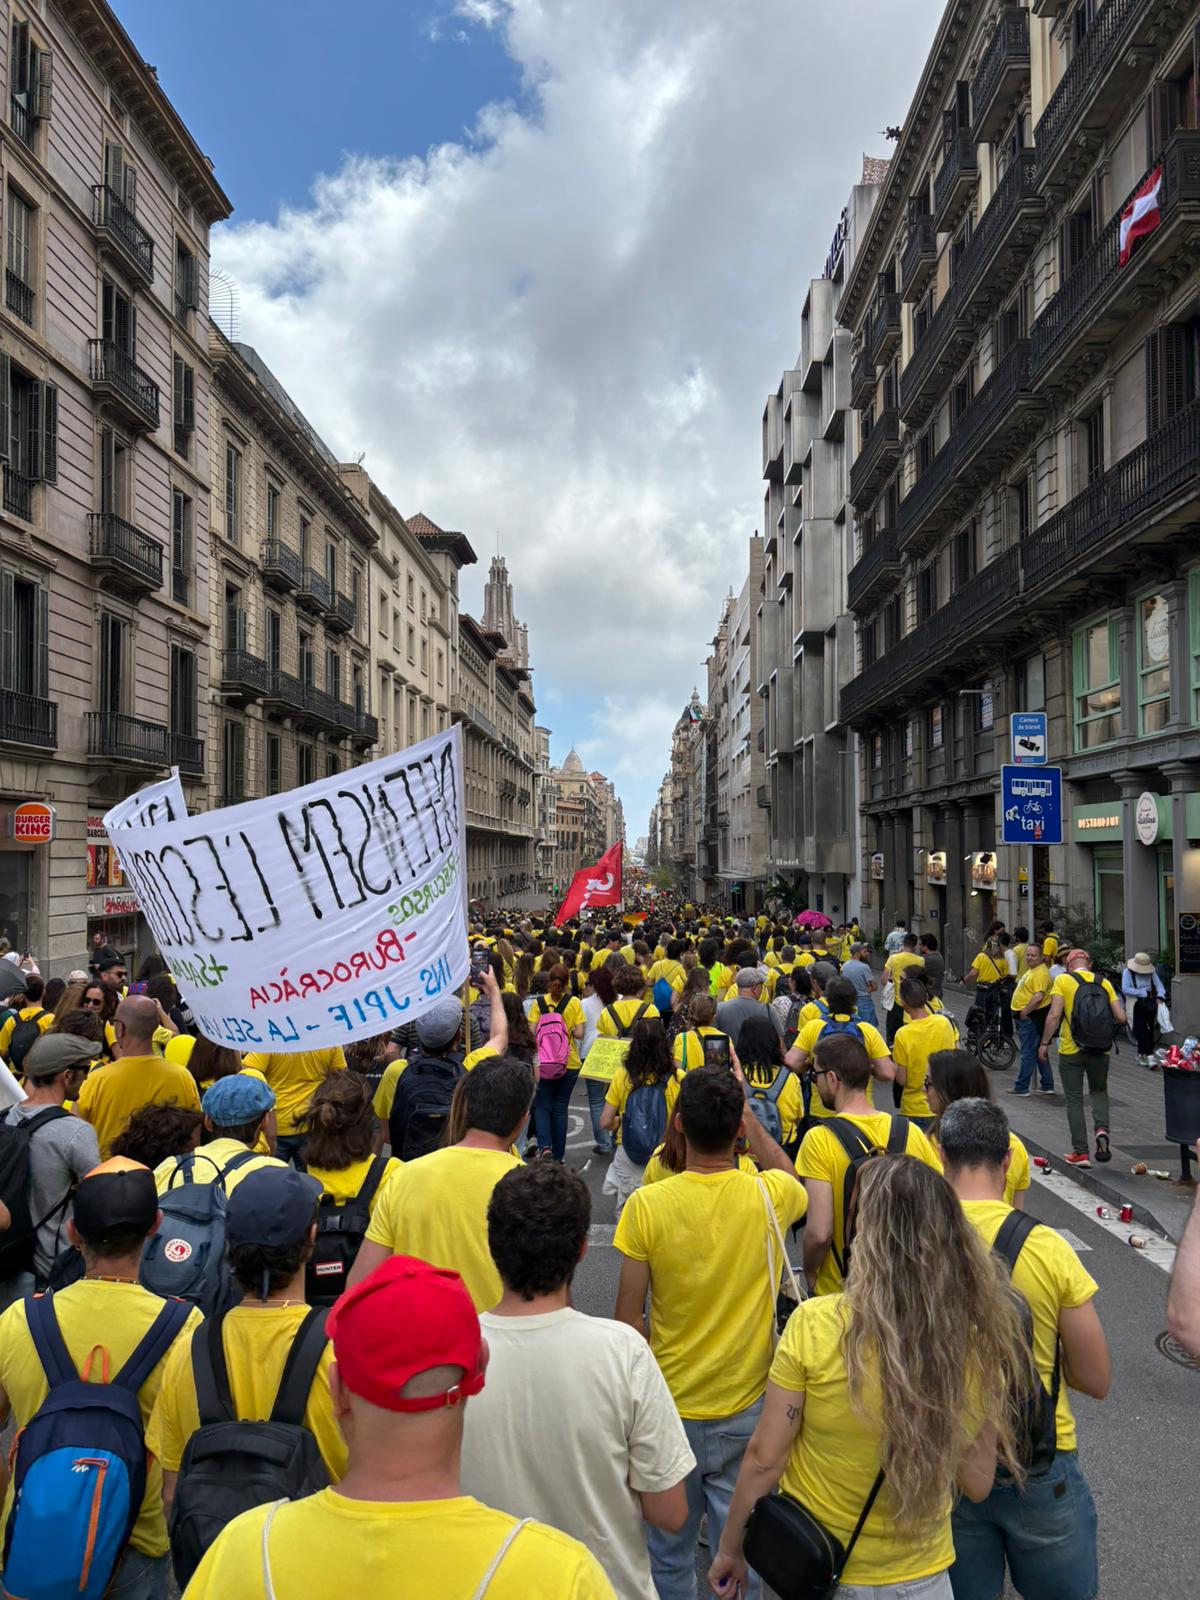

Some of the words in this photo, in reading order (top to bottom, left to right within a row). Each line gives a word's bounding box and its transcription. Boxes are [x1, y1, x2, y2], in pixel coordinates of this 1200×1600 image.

[15, 815, 50, 823] BURGER
[1021, 816, 1045, 831] taxi
[15, 824, 50, 835] KING
[317, 1265, 342, 1273] HUNTER
